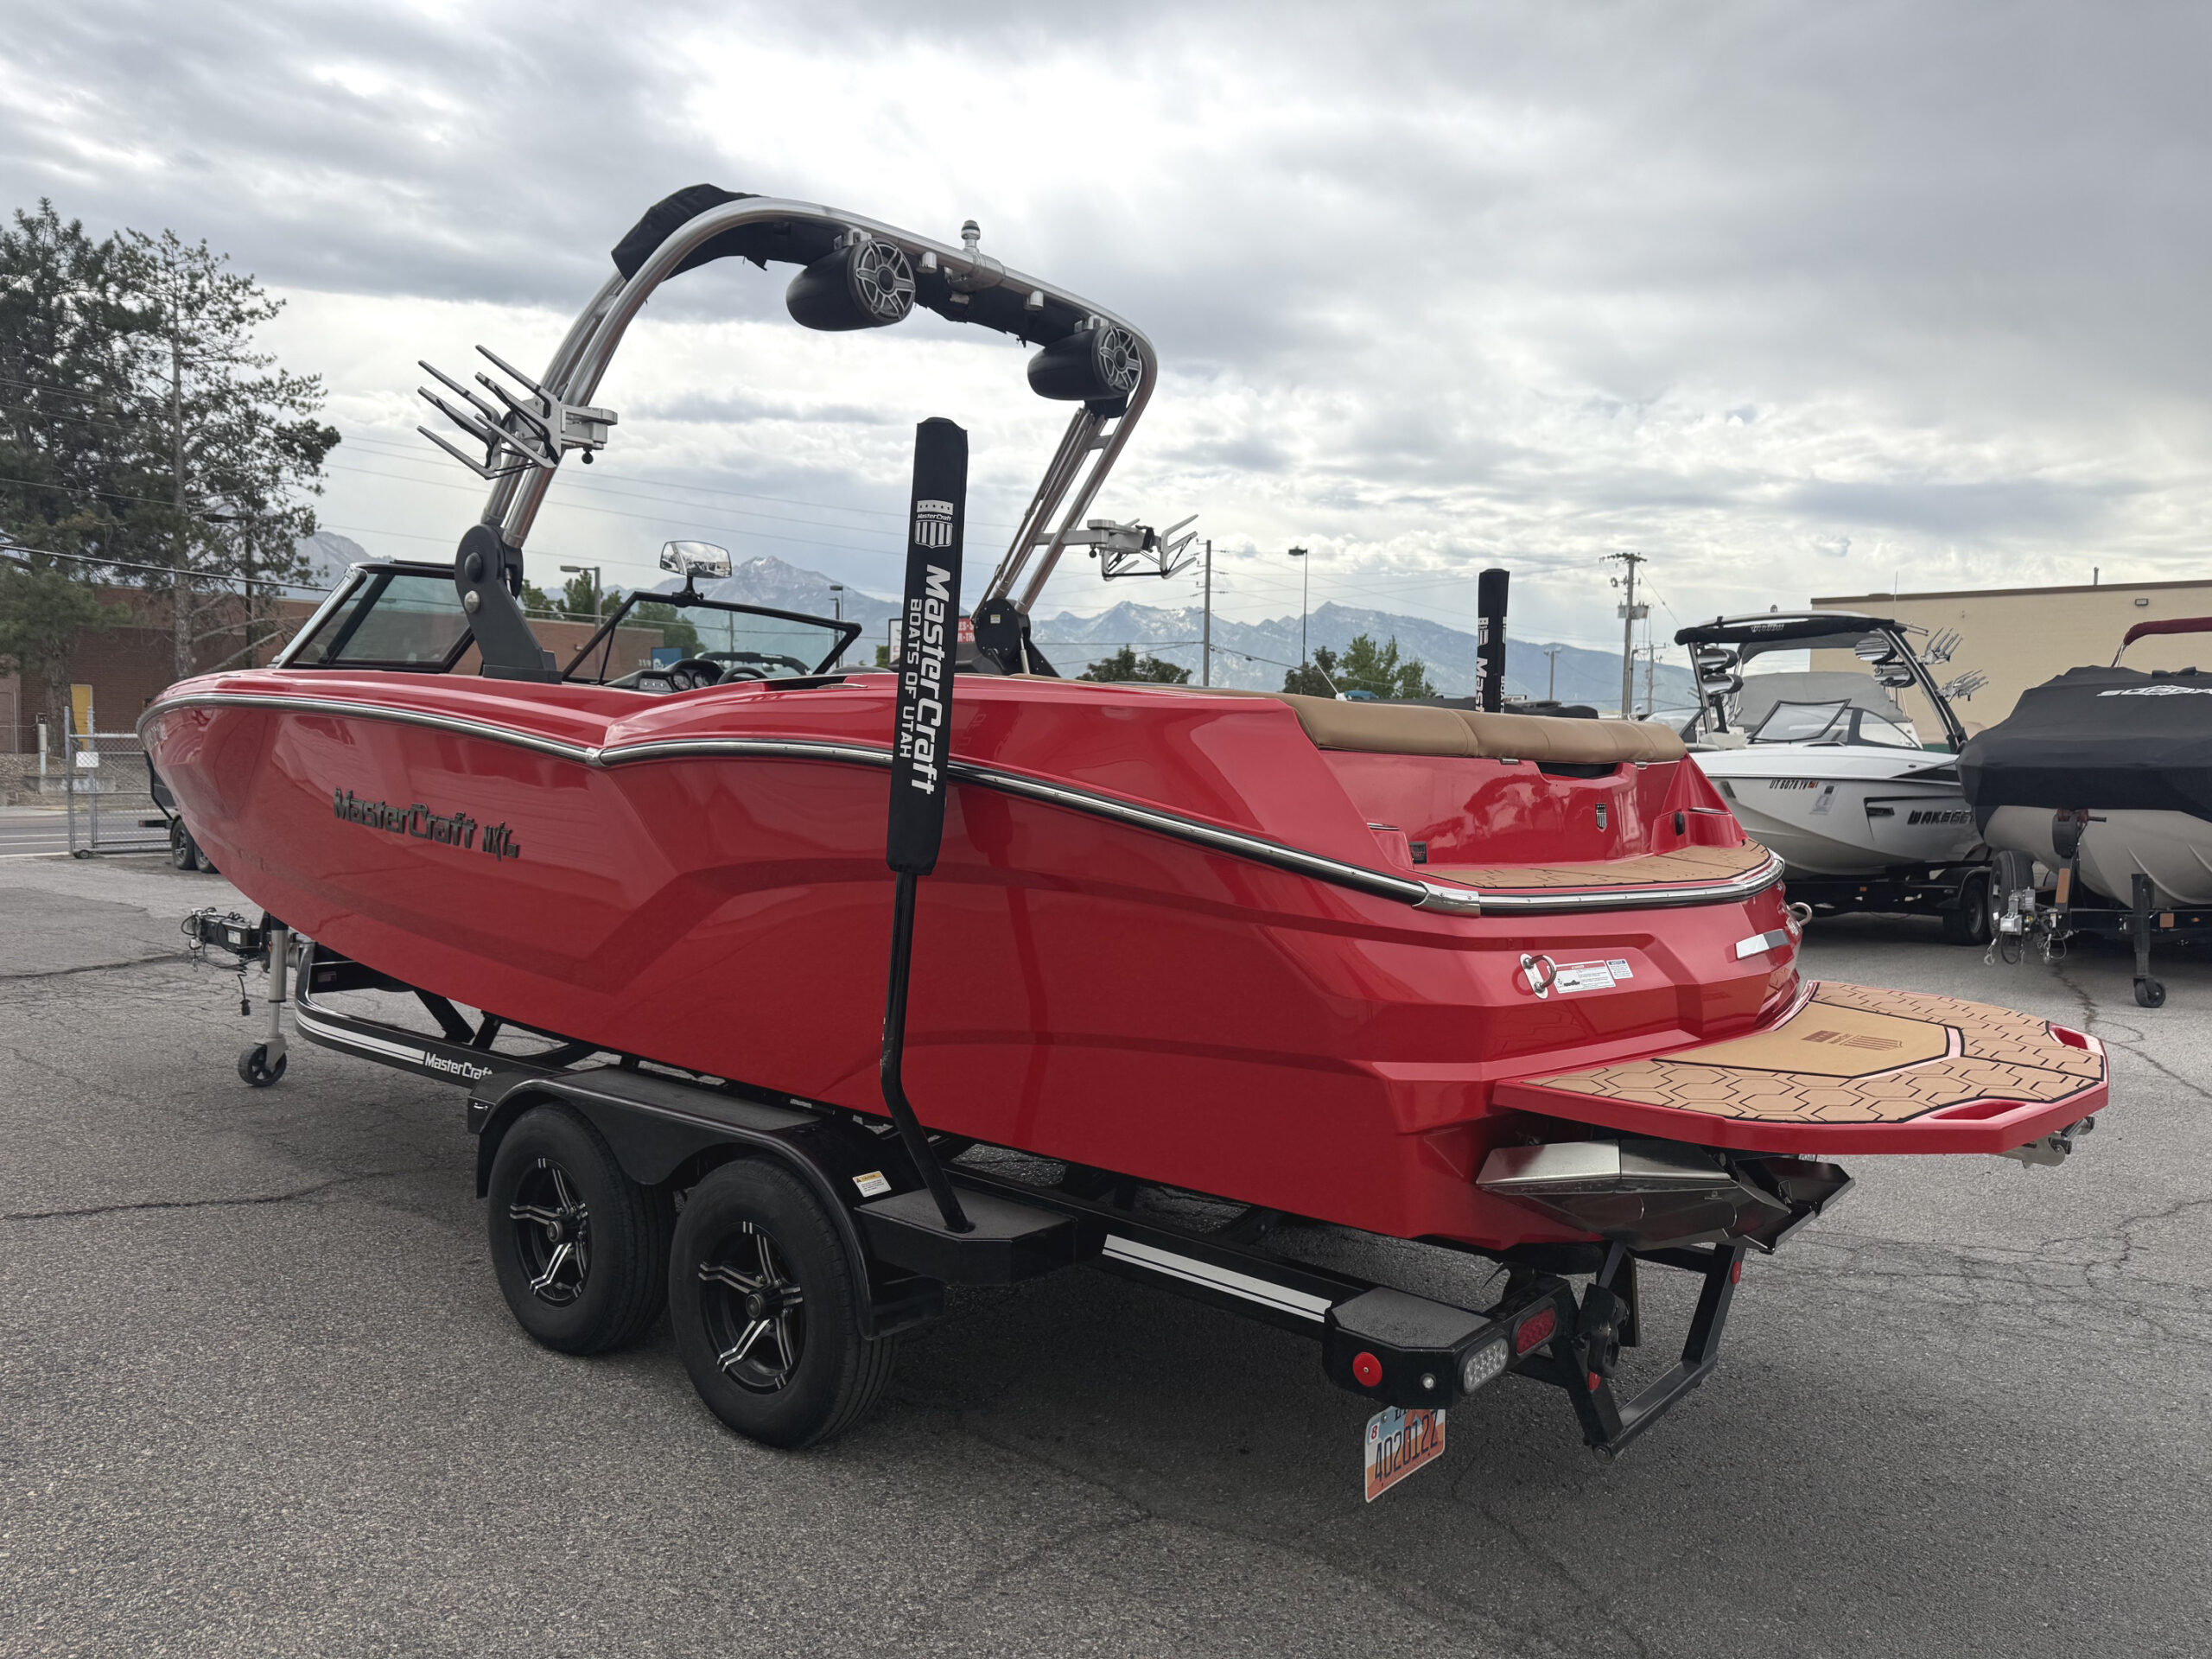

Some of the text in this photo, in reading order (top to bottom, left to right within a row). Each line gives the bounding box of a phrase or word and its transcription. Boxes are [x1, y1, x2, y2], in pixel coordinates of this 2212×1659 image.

[899, 598, 923, 759] BOATS OF UTAH
[911, 564, 951, 795] MasterCraft
[334, 787, 512, 861] MasterCraft NXT
[1371, 1425, 1378, 1440] 8
